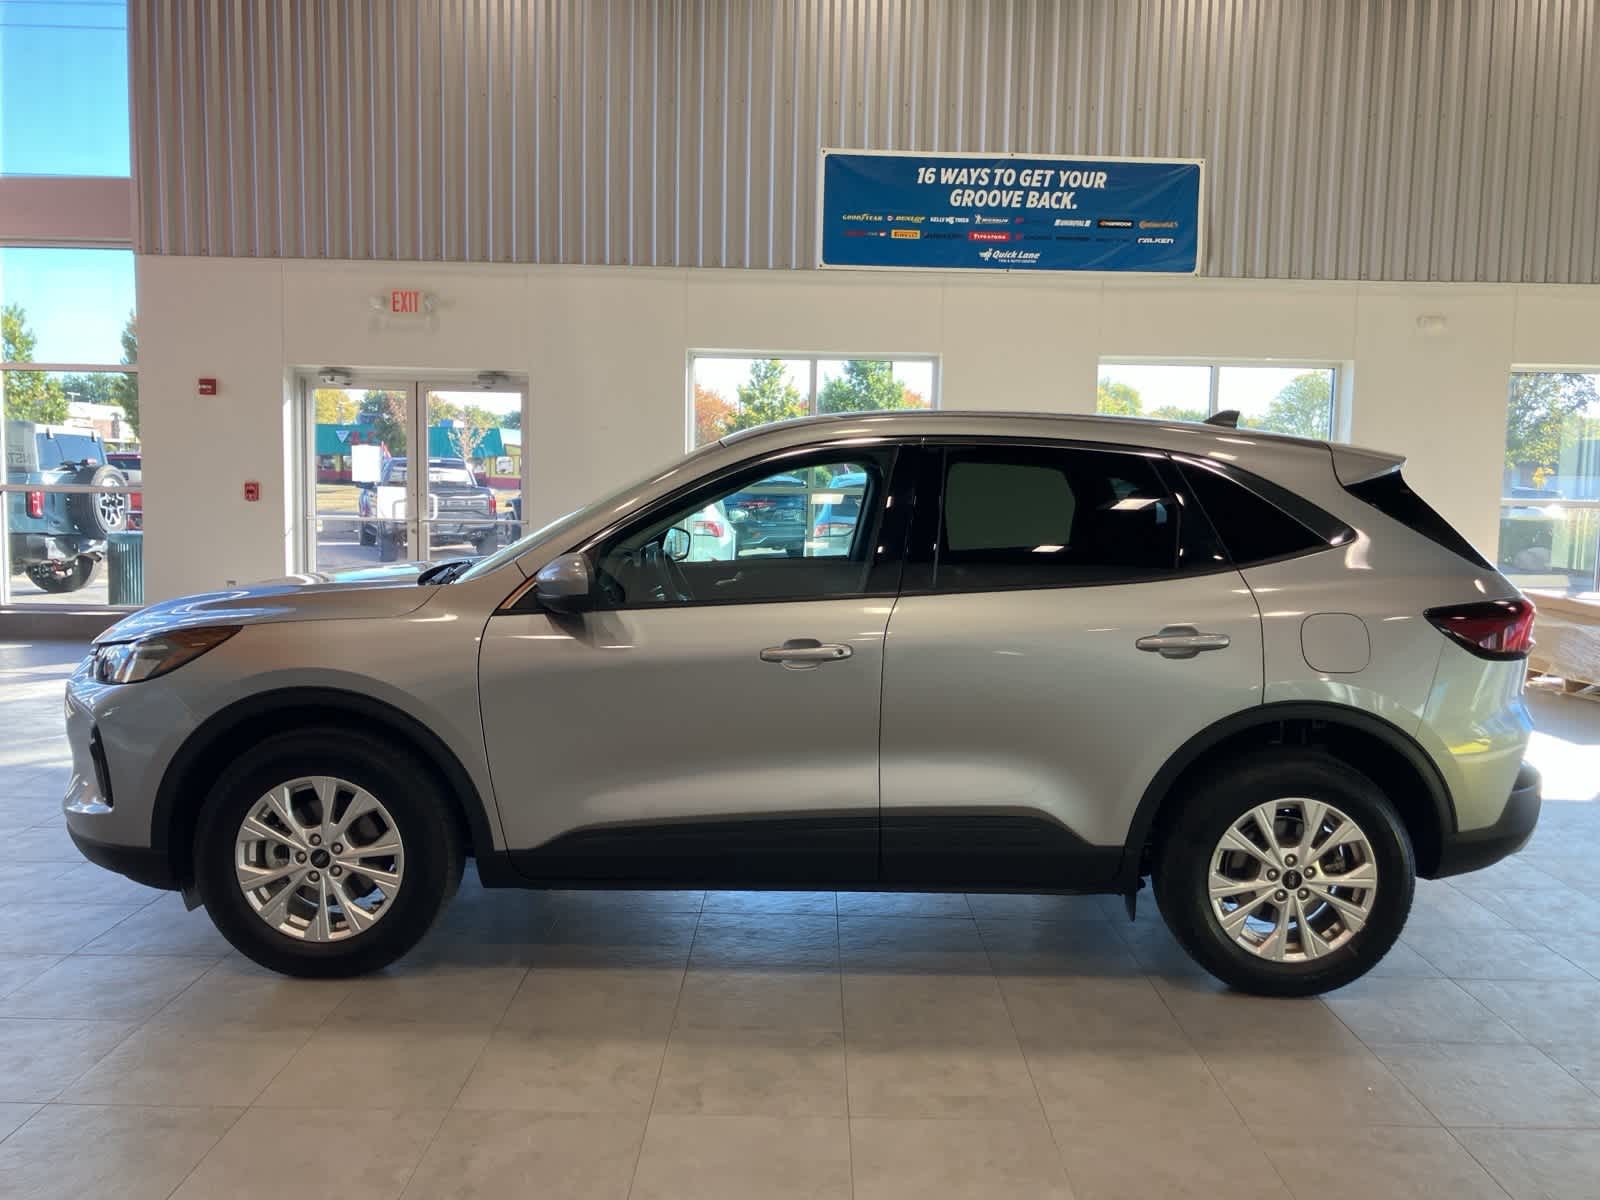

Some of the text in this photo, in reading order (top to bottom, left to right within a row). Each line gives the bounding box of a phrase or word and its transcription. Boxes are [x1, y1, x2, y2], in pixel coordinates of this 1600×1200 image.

[917, 167, 1107, 189] 16 WAYS TO GET YOUR
[950, 189, 1078, 210] GROOVE BACK.
[992, 250, 1040, 260] Quick Lane
[391, 290, 419, 313] EXIT
